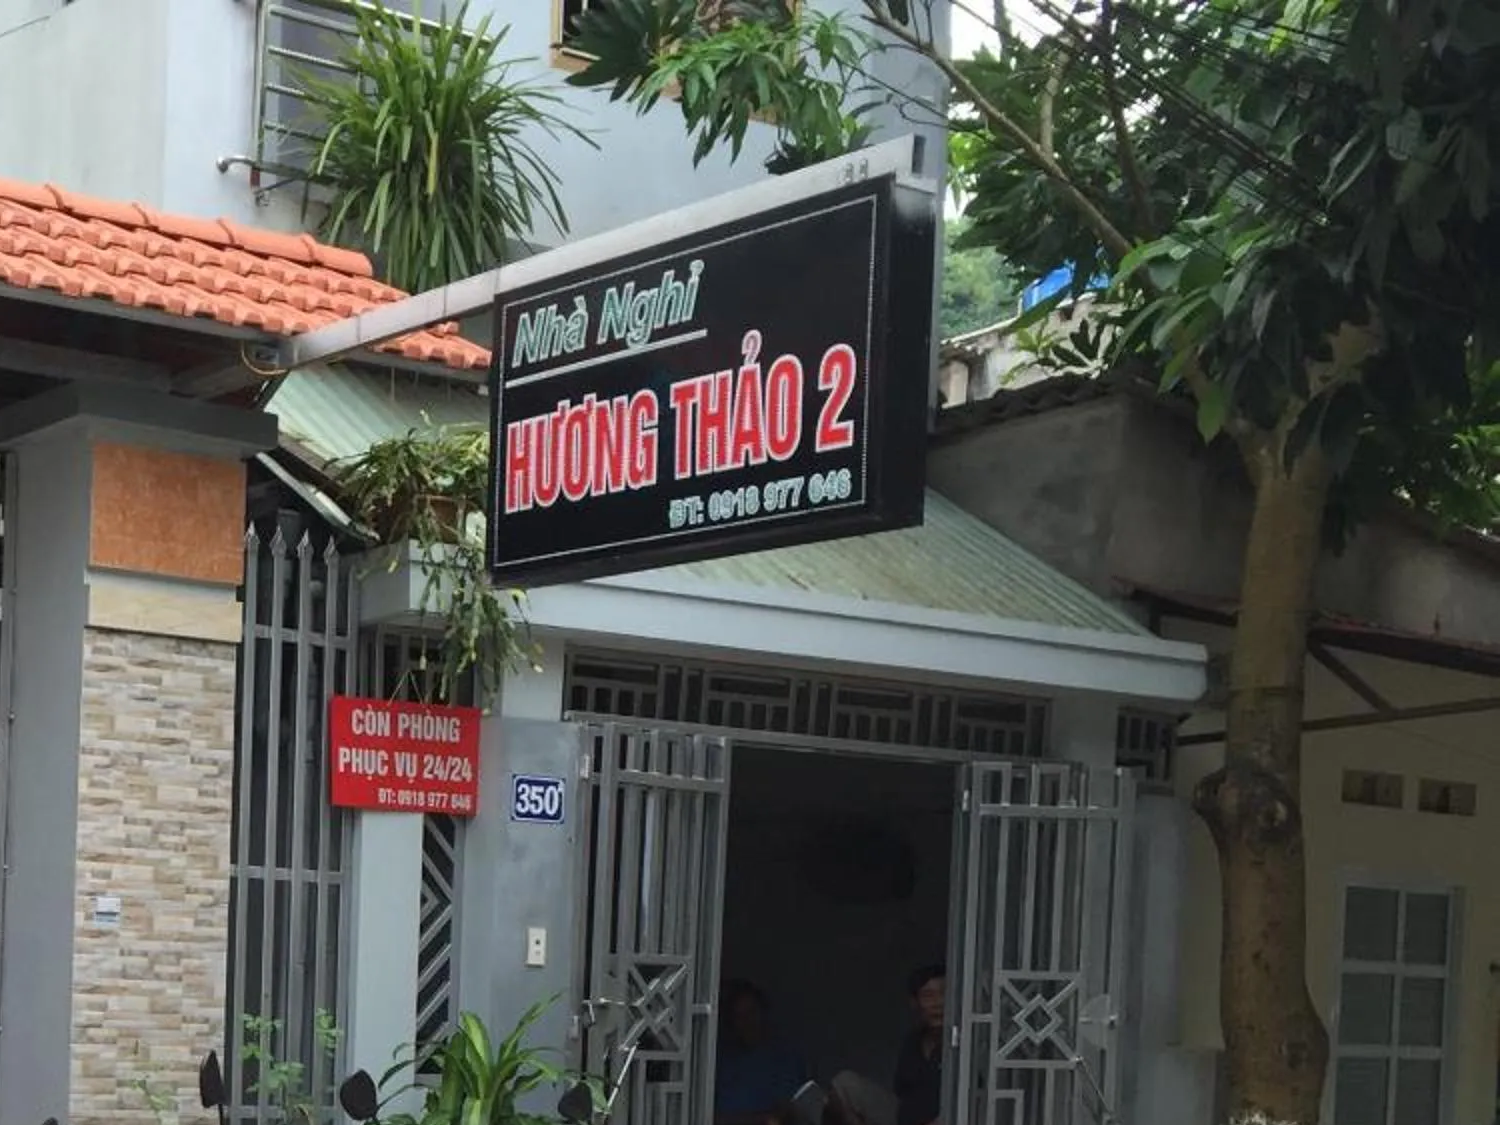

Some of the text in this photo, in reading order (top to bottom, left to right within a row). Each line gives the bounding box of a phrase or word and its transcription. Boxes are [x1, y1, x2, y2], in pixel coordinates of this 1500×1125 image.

[511, 259, 705, 369] Nhà Nghỉ
[504, 330, 858, 514] HƯƠNG THẢO 2
[708, 486, 760, 521] 0918
[764, 476, 804, 511] 977
[351, 704, 461, 743] CÒN PHÒNG
[338, 746, 473, 784] PHỤC VỤ 24/24
[515, 783, 559, 816] 350
